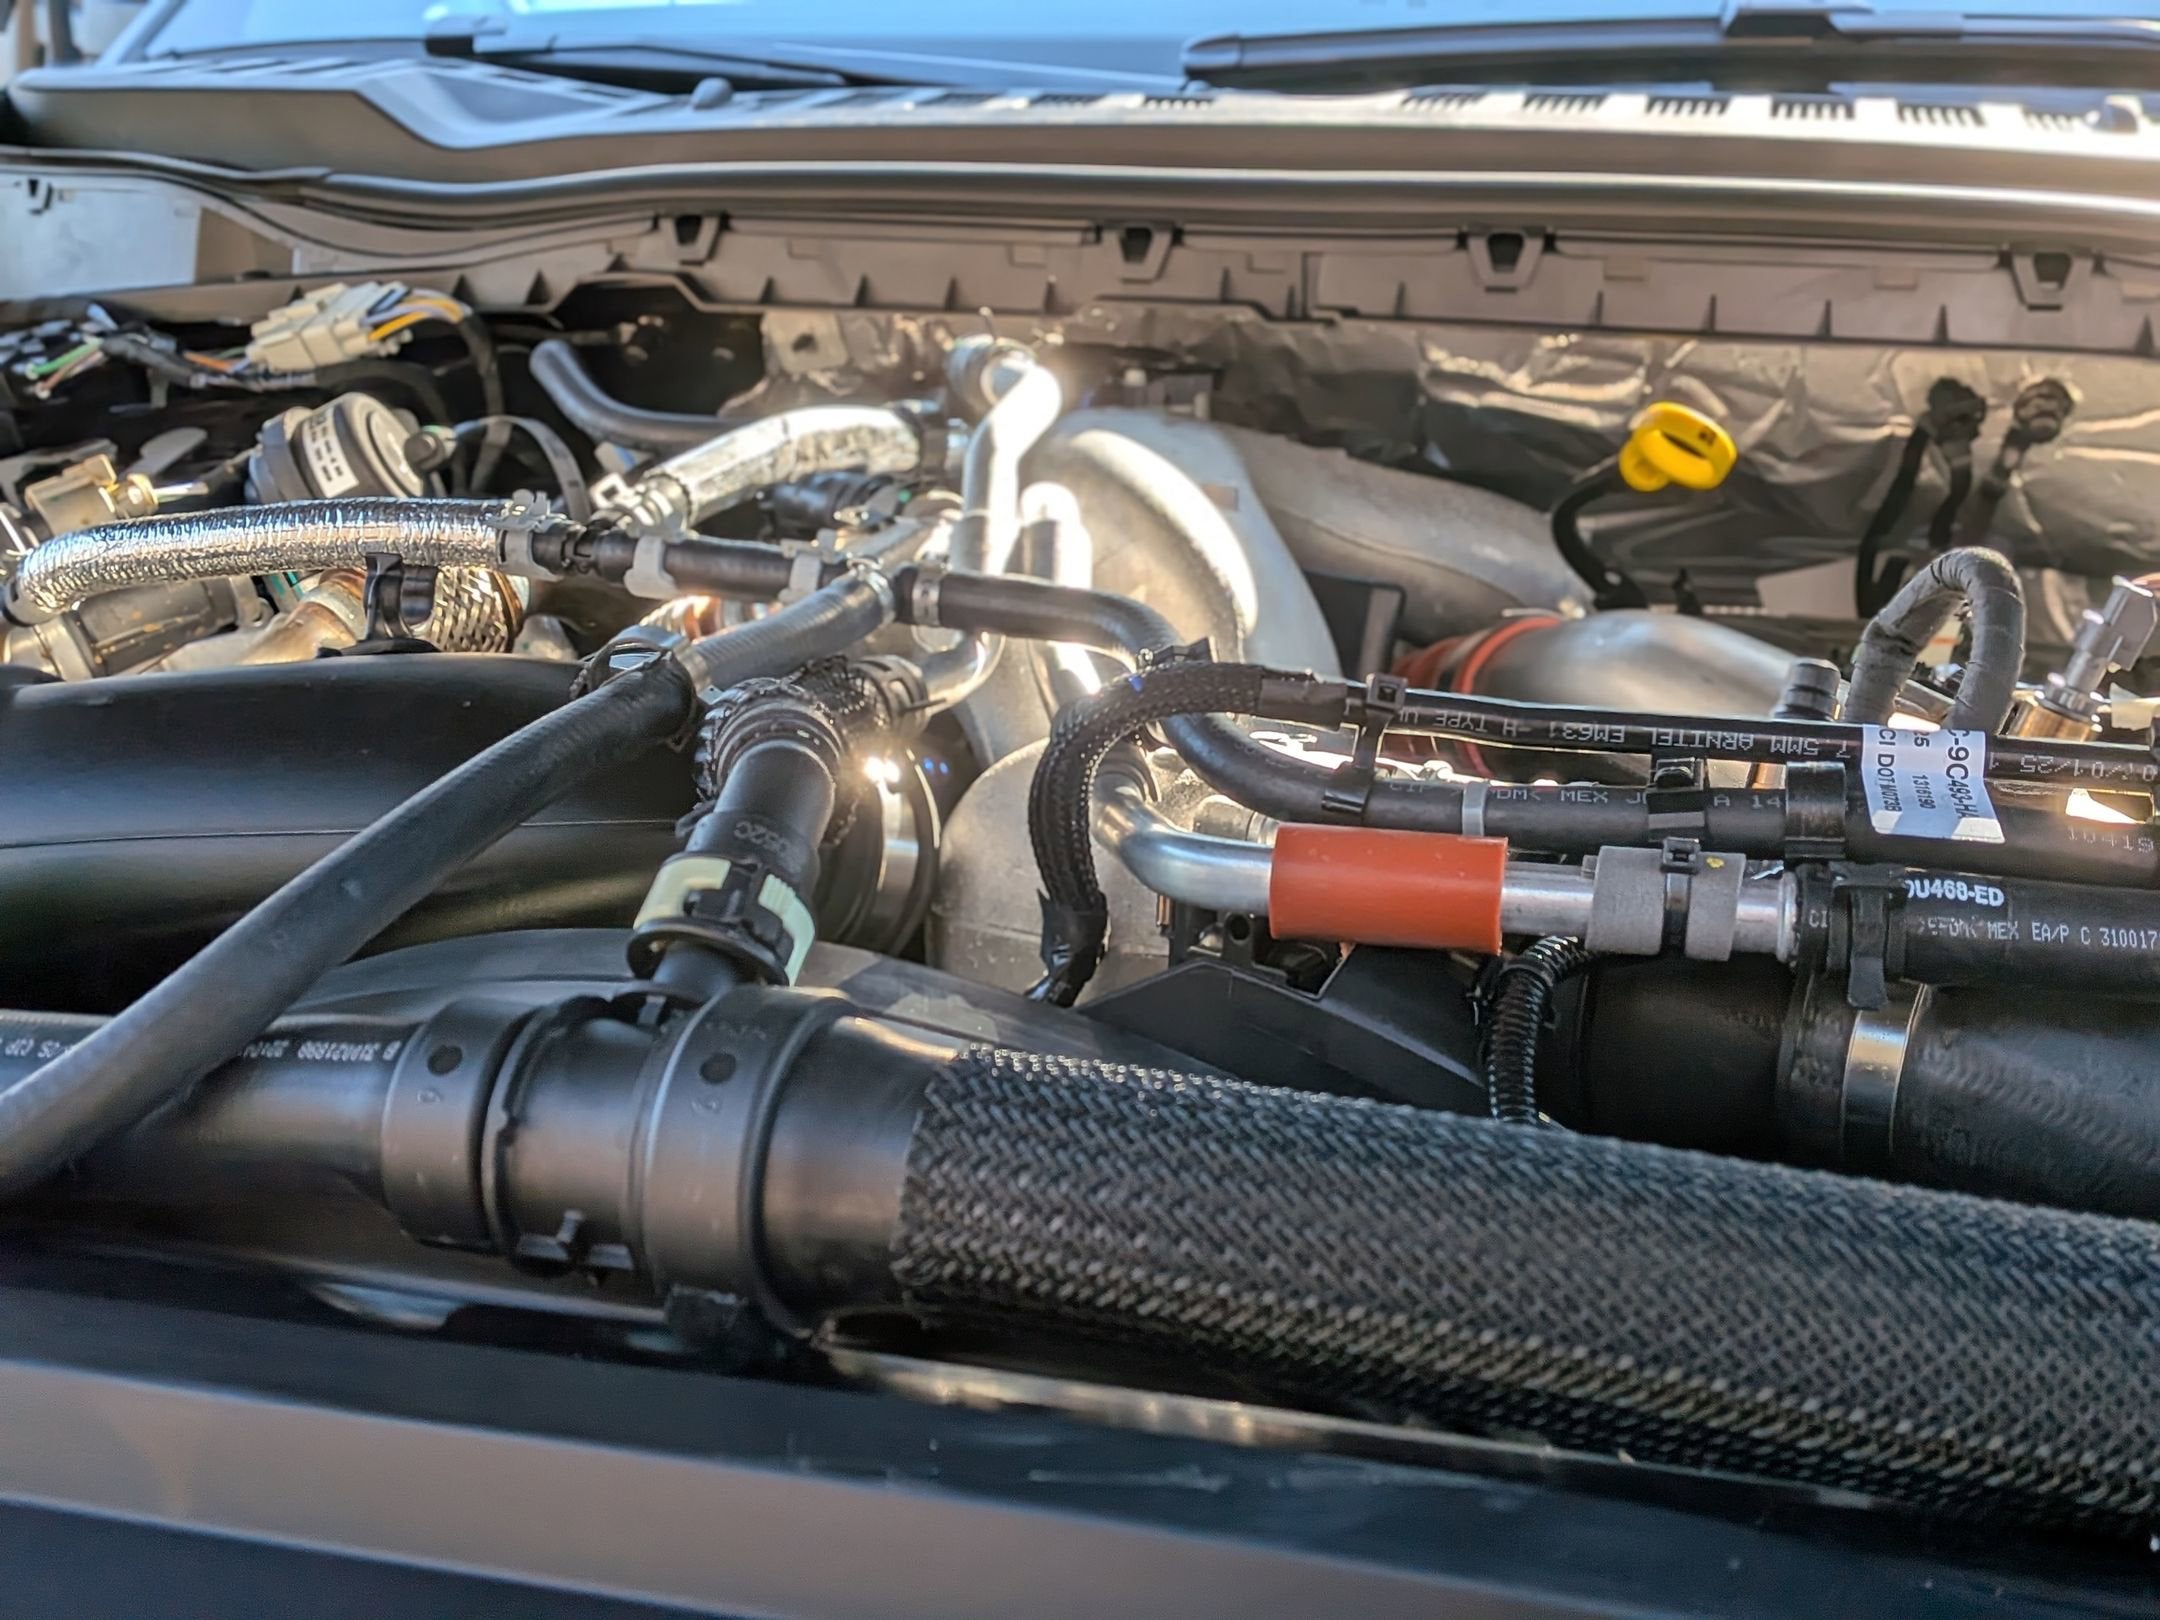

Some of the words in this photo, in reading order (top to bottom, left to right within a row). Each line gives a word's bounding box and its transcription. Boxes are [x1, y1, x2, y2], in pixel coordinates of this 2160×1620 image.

[1433, 709, 1487, 732] TYPE
[1650, 727, 1755, 751] ARNITEL
[1560, 789, 1609, 804] MEX
[1987, 919, 2020, 940] MEX
[2031, 922, 2070, 944] EA/P
[2080, 926, 2091, 945] C
